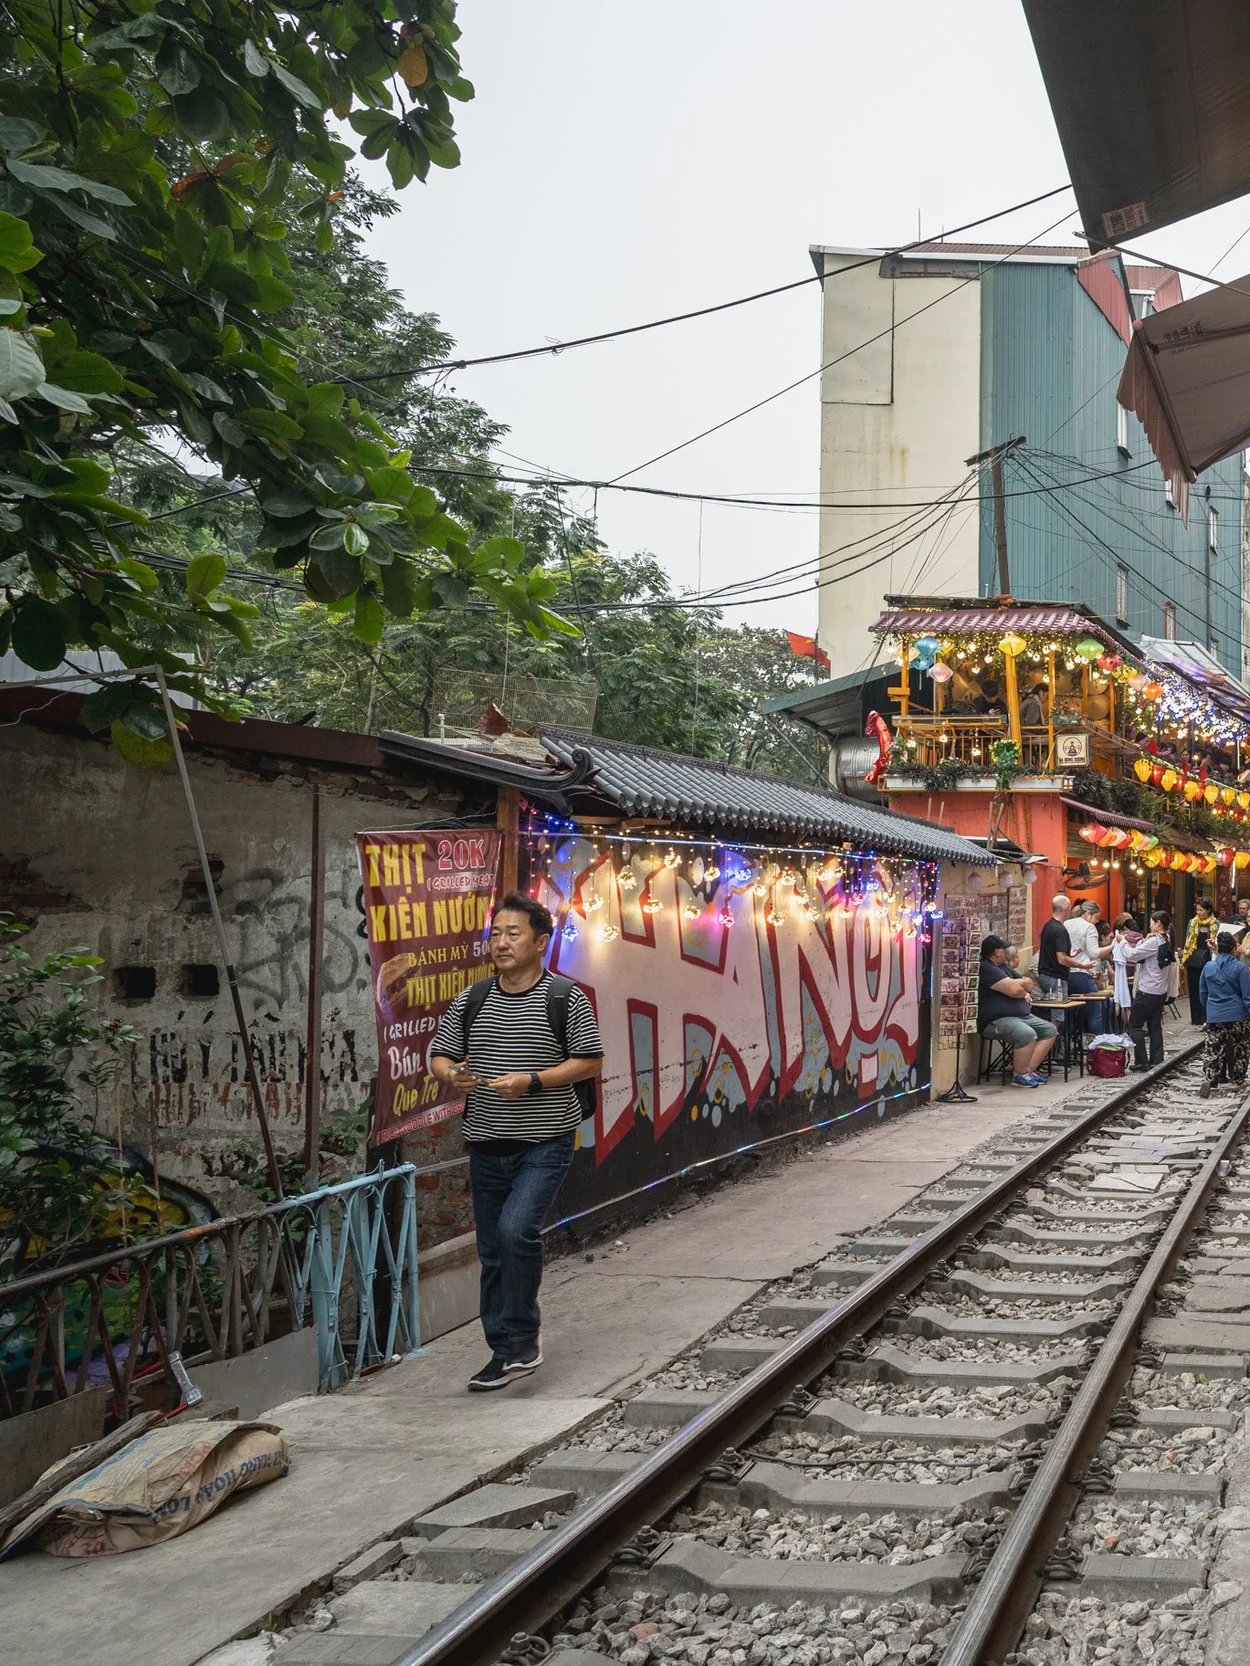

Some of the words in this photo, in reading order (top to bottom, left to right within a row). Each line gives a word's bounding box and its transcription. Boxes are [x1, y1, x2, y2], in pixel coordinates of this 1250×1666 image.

[365, 843, 426, 894] THỊT
[437, 839, 486, 871] 20K
[369, 896, 428, 943] KIÊN
[433, 891, 492, 936] NƯỚN
[407, 947, 447, 968] BÁNH
[473, 940, 491, 958] 50
[406, 974, 437, 1011] THỊT
[387, 1045, 423, 1080] Bún
[393, 1082, 418, 1117] Que
